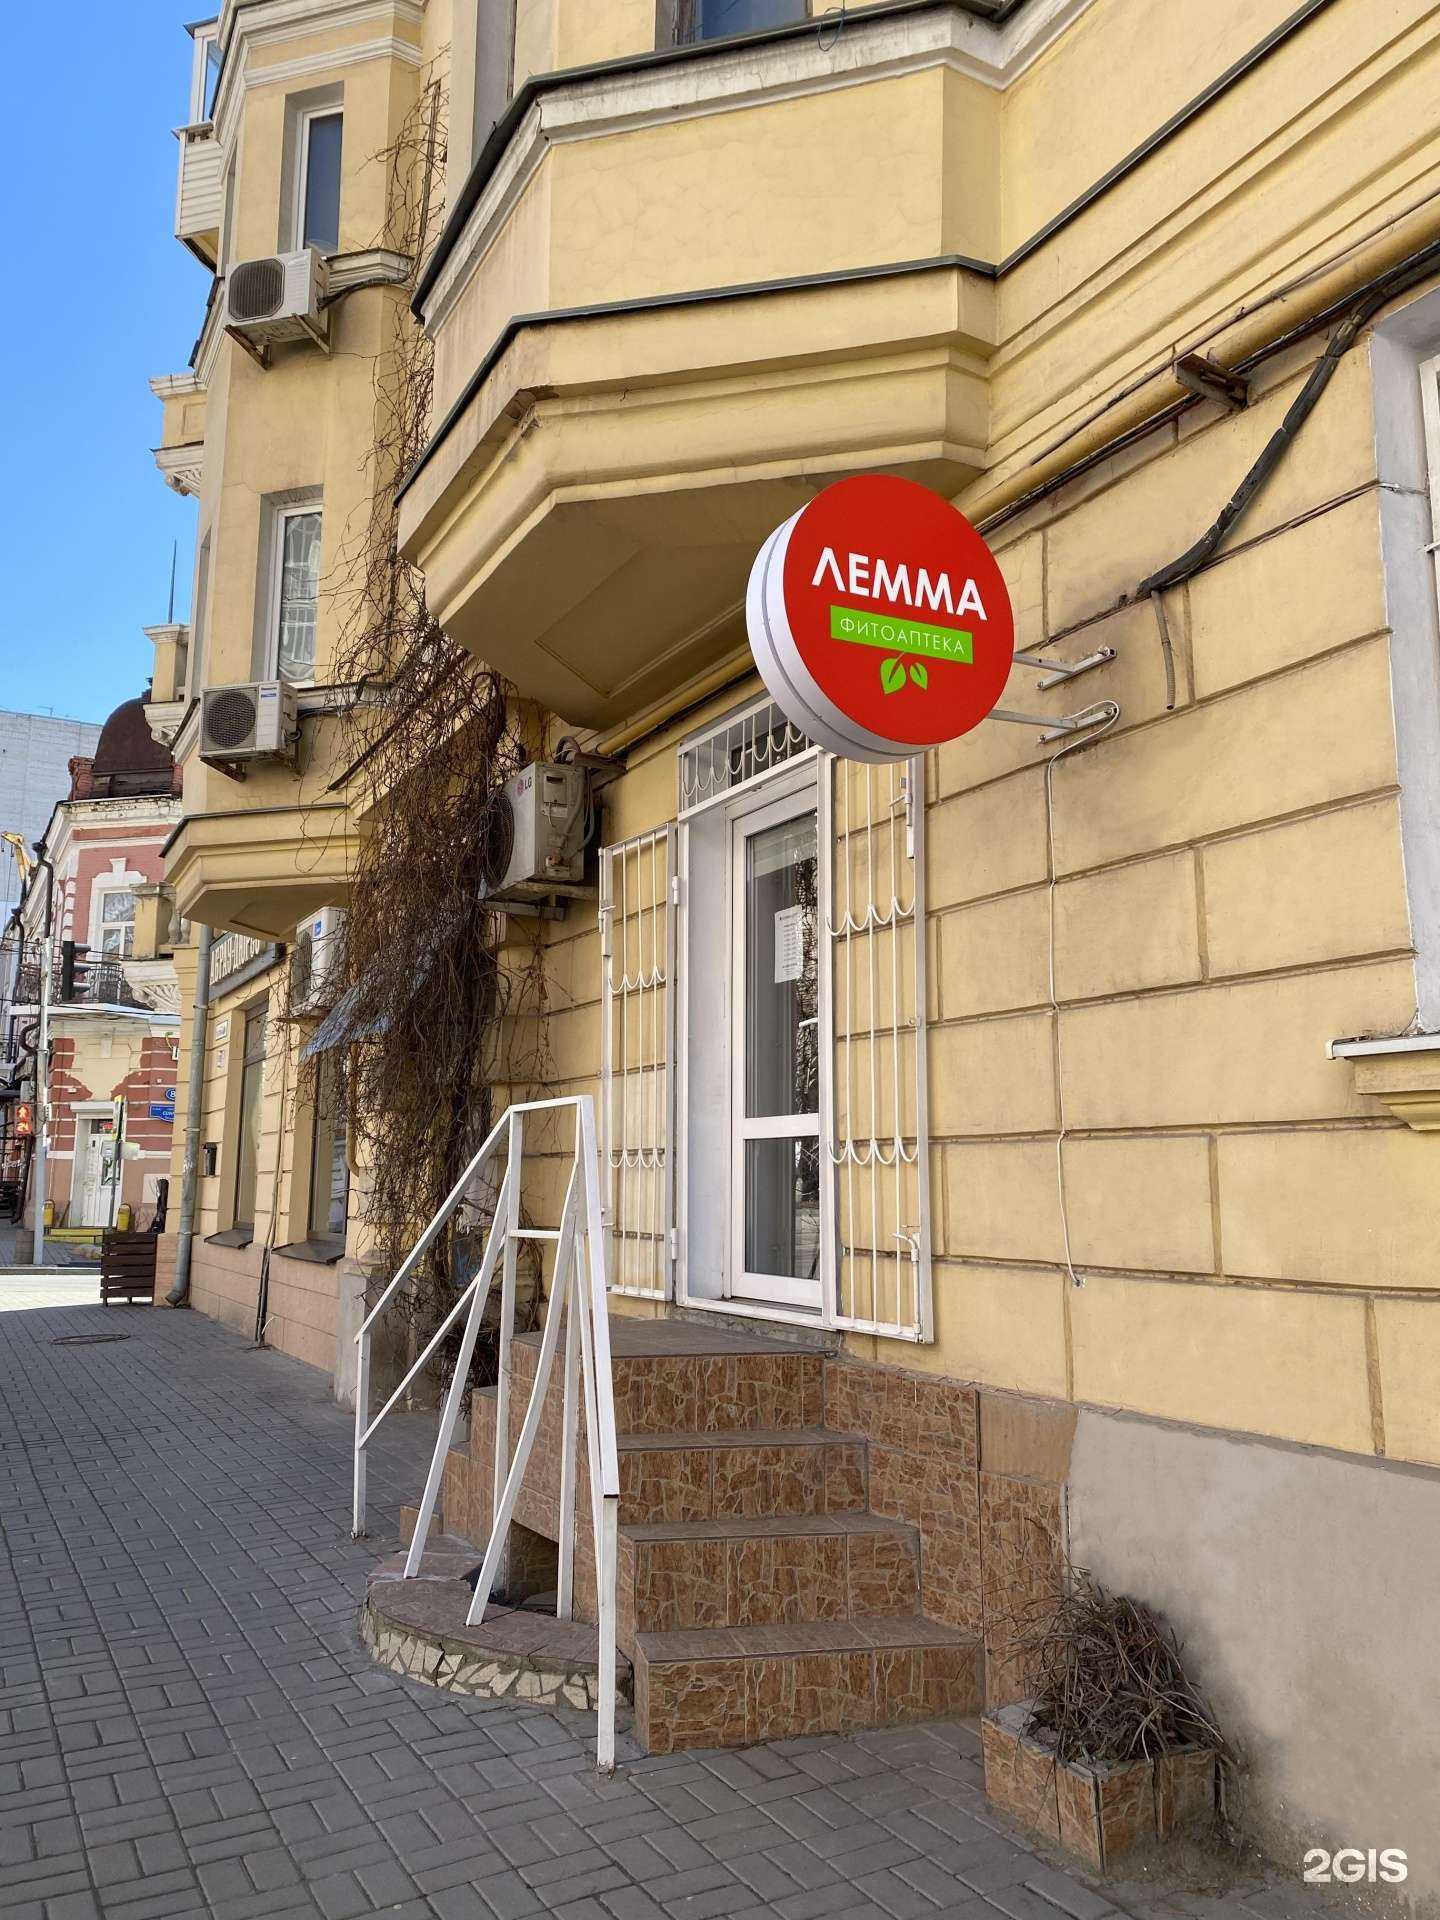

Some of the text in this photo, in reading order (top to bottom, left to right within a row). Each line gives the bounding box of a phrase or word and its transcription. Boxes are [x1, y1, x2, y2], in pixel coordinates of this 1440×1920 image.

[811, 546, 988, 621] ЛЕММА
[840, 616, 965, 655] ФИТОАПТЕКА
[524, 776, 532, 790] LG
